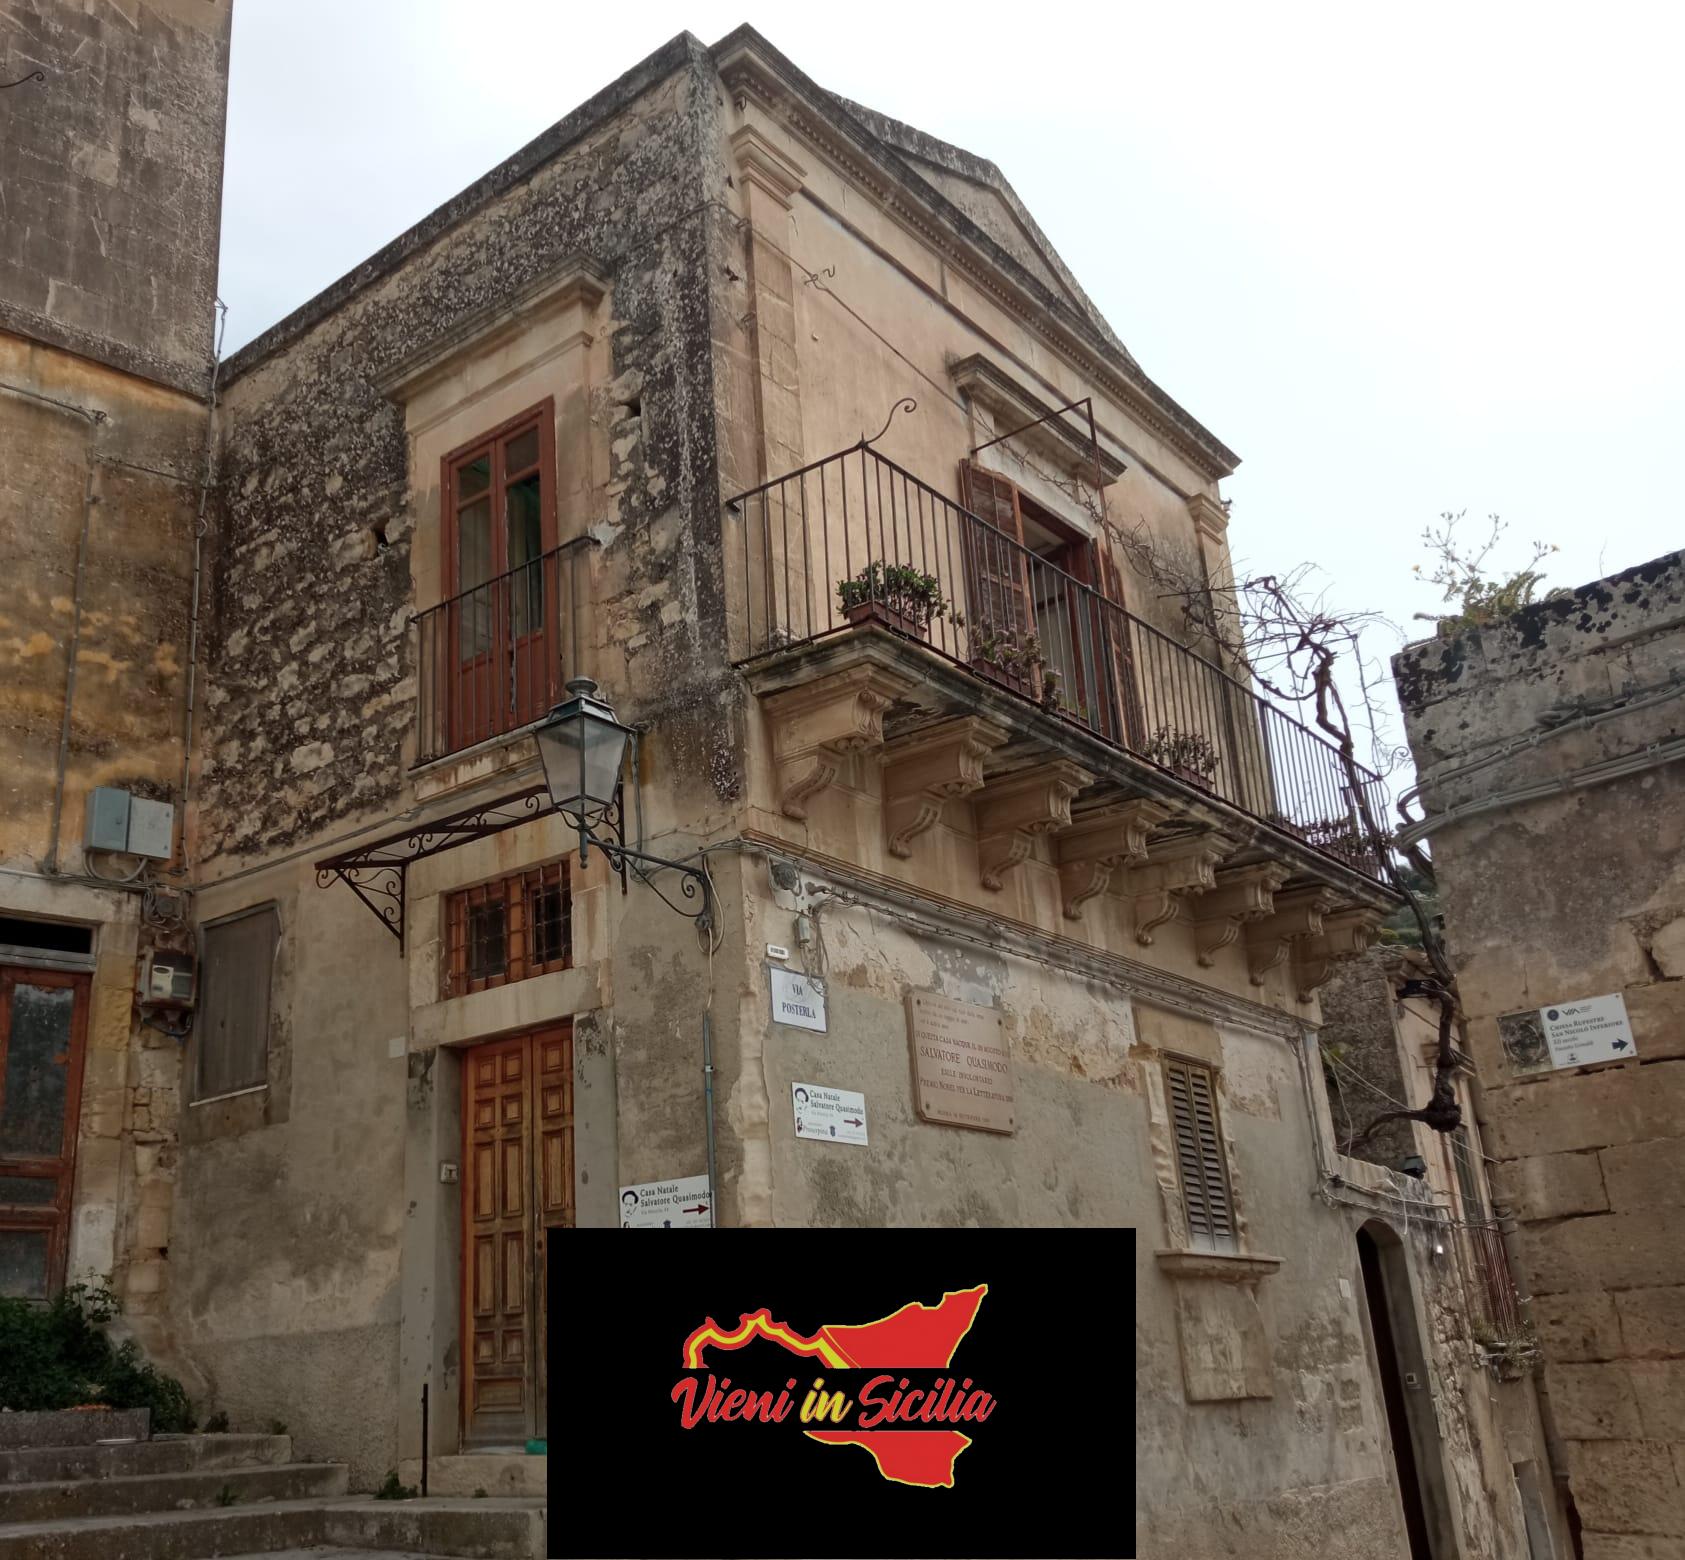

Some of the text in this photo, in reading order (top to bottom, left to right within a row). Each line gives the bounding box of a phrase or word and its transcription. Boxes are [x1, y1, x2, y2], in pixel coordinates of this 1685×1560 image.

[792, 984, 803, 996] VIA
[782, 1002, 816, 1019] POSTERLA
[920, 1046, 1008, 1073] SALVATORE QUASIMODO
[810, 1090, 840, 1102] Casa Natale
[811, 1099, 834, 1110] Salvatore
[835, 1103, 863, 1115] Quasimodo
[640, 1184, 678, 1197] Casa Natale
[640, 1190, 711, 1208] Salvatore Quasimodo
